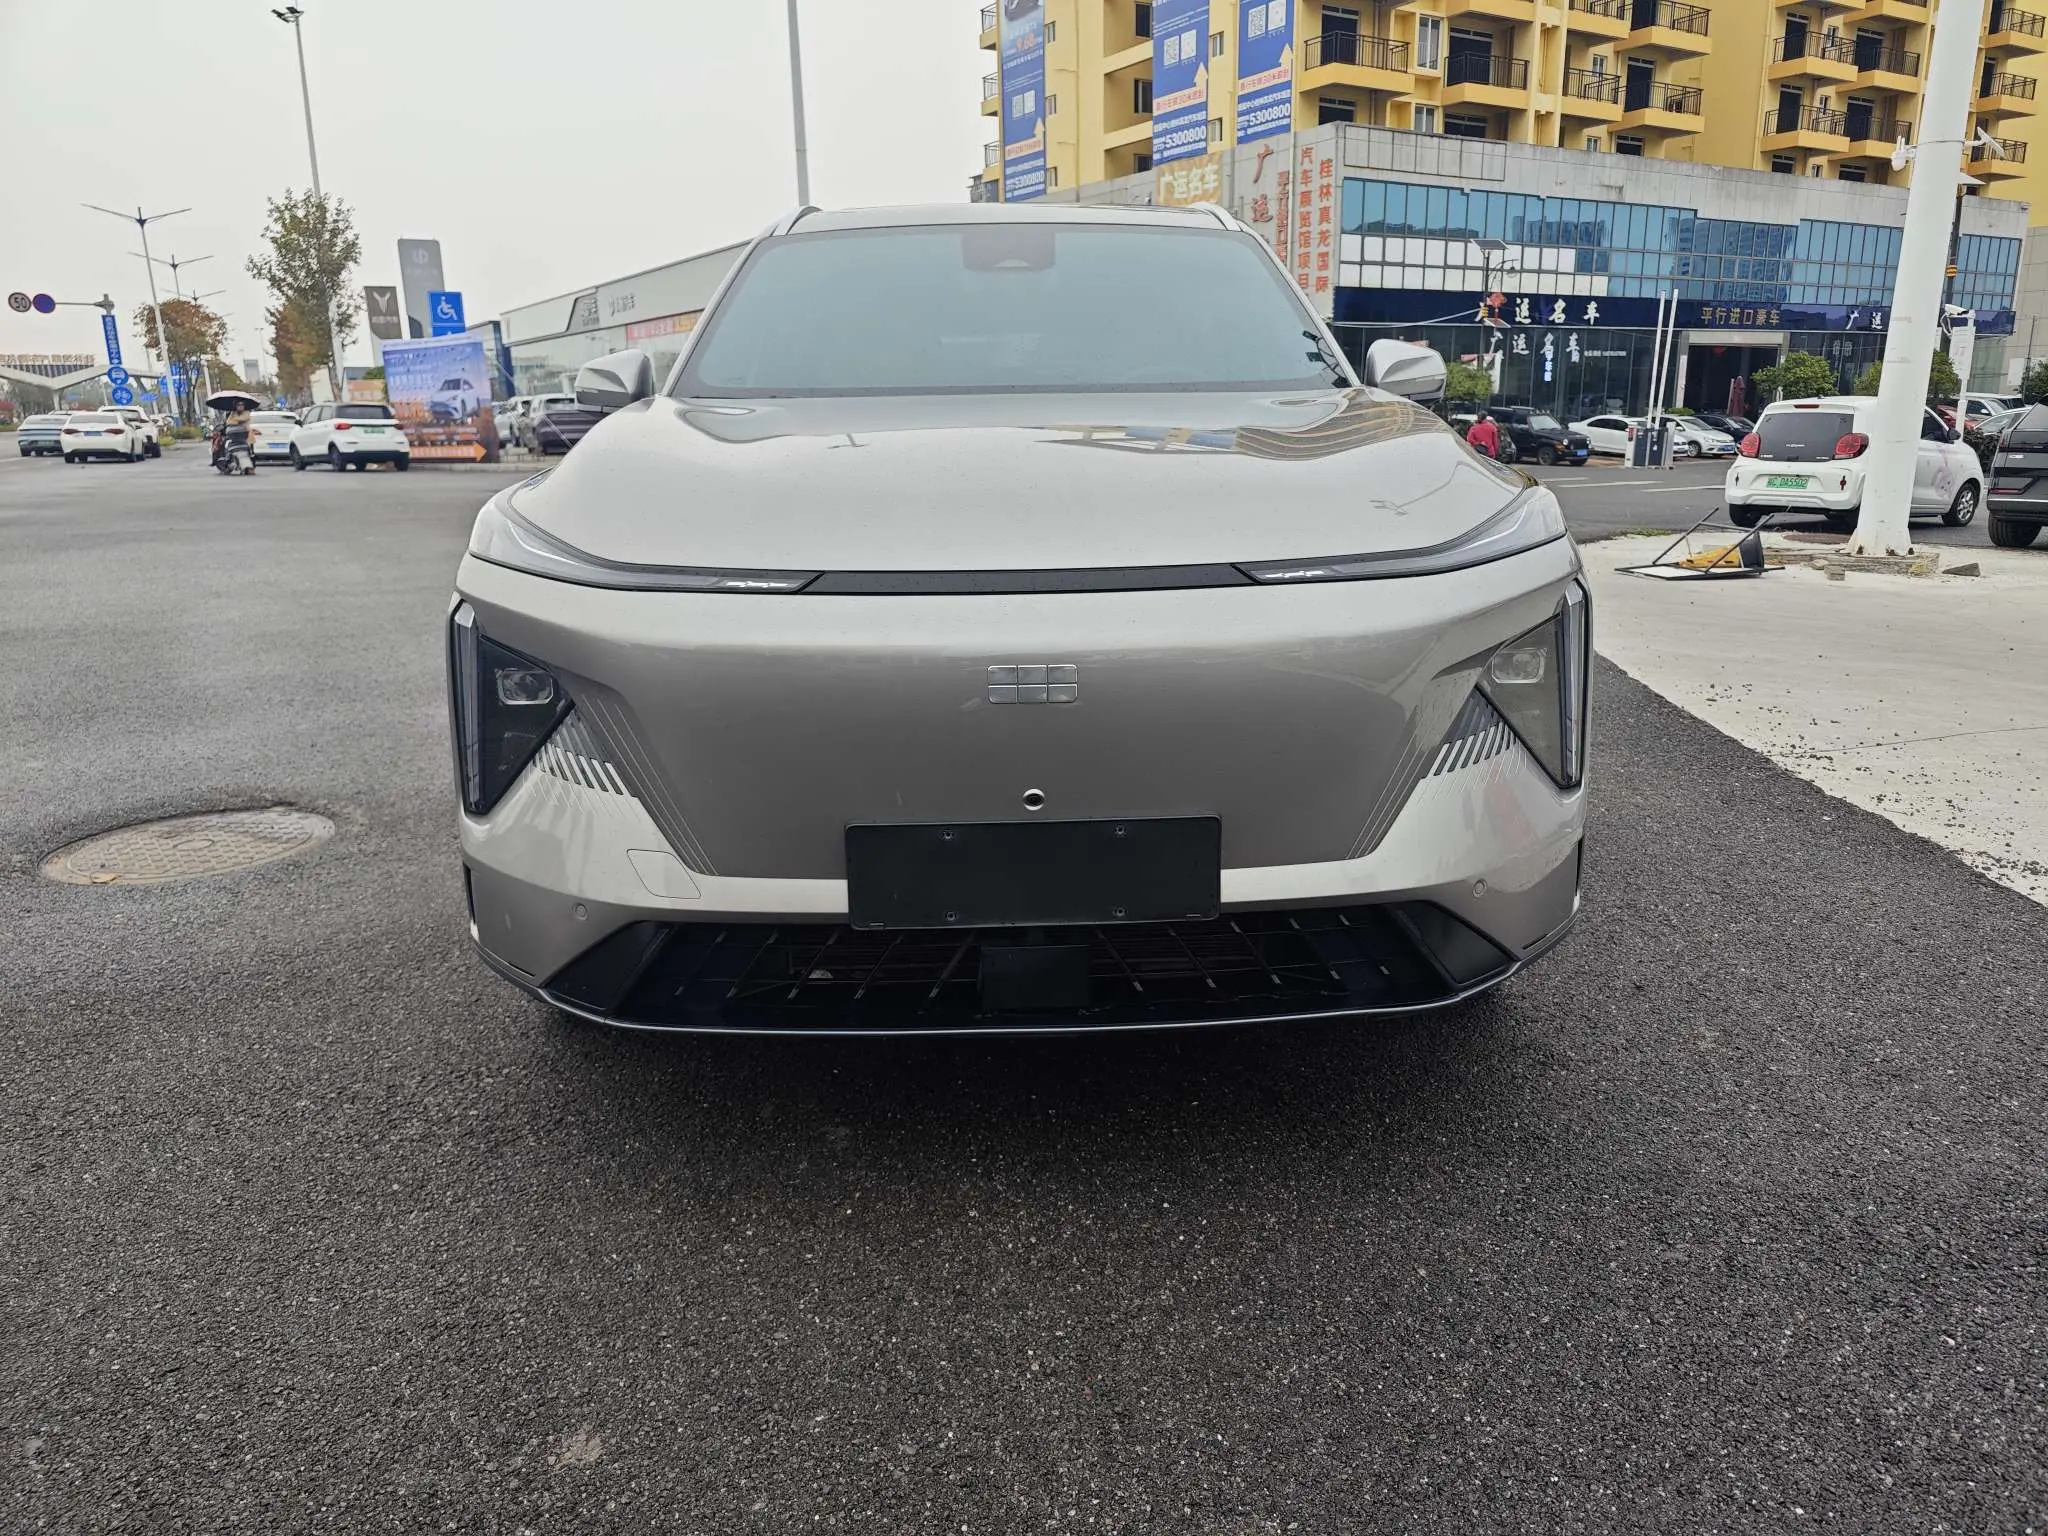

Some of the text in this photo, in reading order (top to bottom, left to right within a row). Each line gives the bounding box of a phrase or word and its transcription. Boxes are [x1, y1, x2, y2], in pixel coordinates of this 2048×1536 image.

[1249, 103, 1291, 126] 5300800
[1165, 126, 1206, 148] 5300800
[1316, 158, 1333, 293] 桂林真龙国际
[14, 297, 27, 309] 50
[1701, 307, 1781, 327] 平行进口豪车
